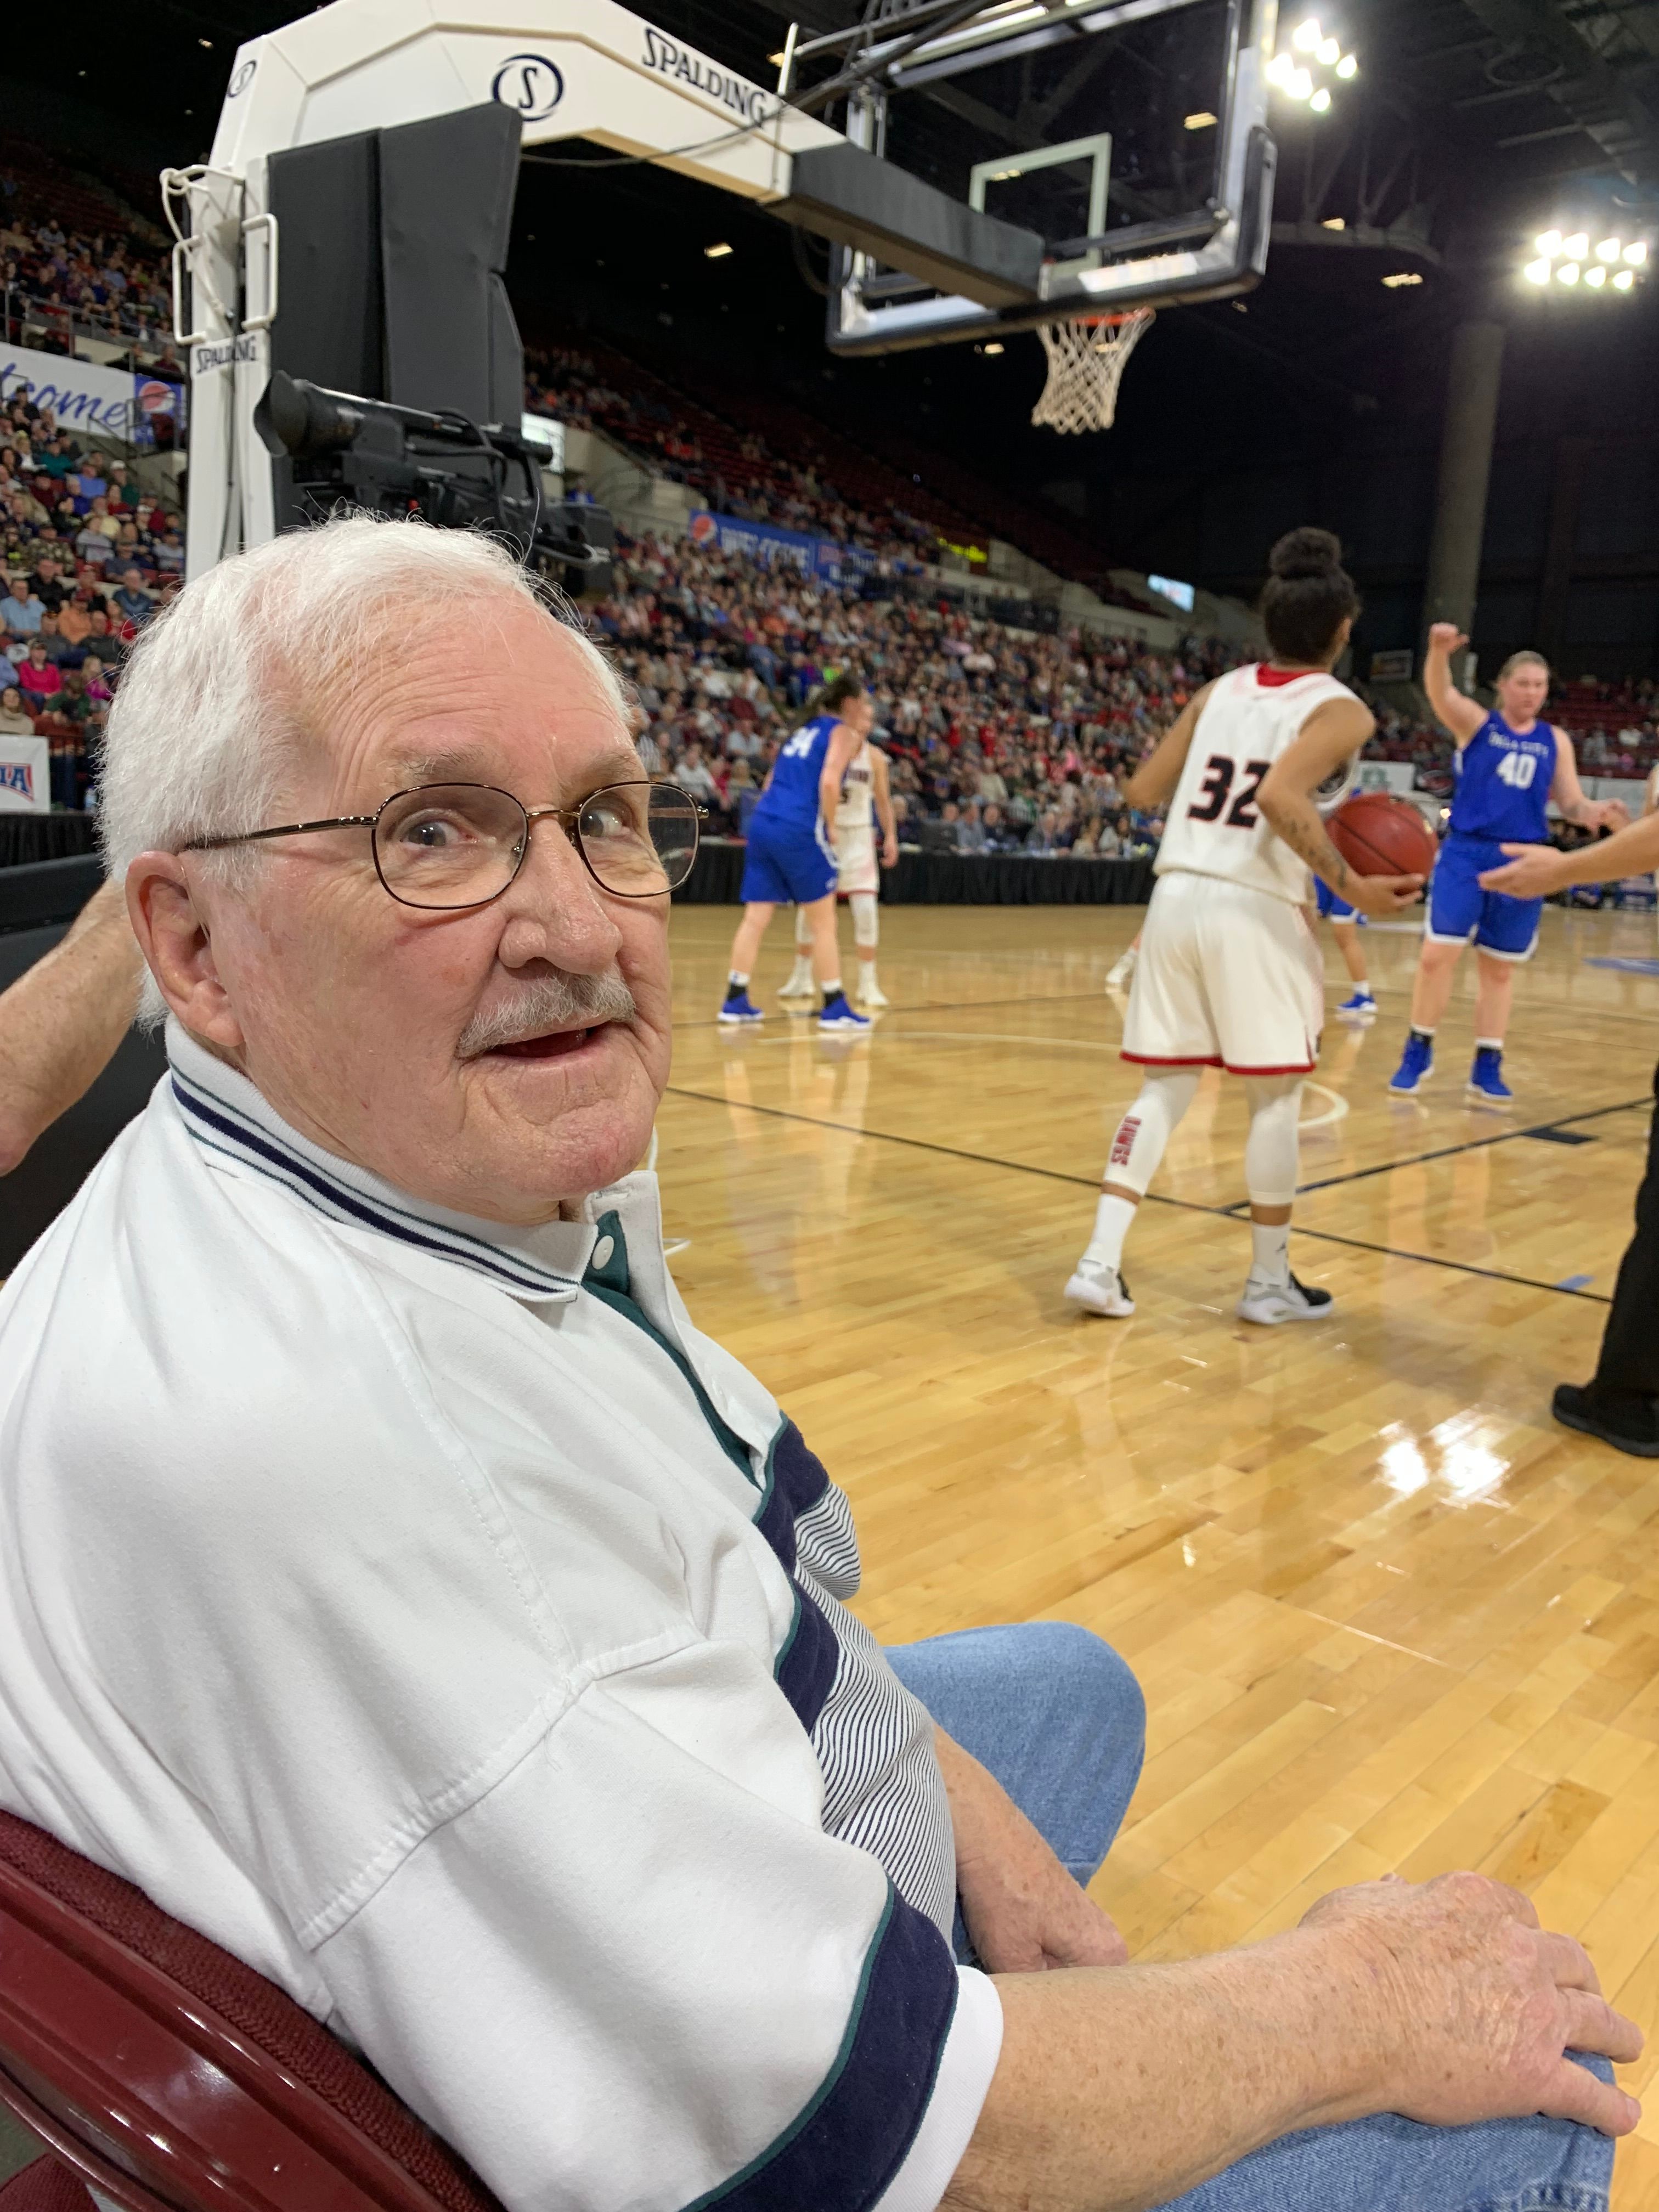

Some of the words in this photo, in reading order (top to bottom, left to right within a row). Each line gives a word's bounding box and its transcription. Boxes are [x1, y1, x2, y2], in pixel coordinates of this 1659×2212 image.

[642, 27, 764, 128] SPALDING
[1187, 754, 1272, 829] 32
[1496, 751, 1538, 789] 40
